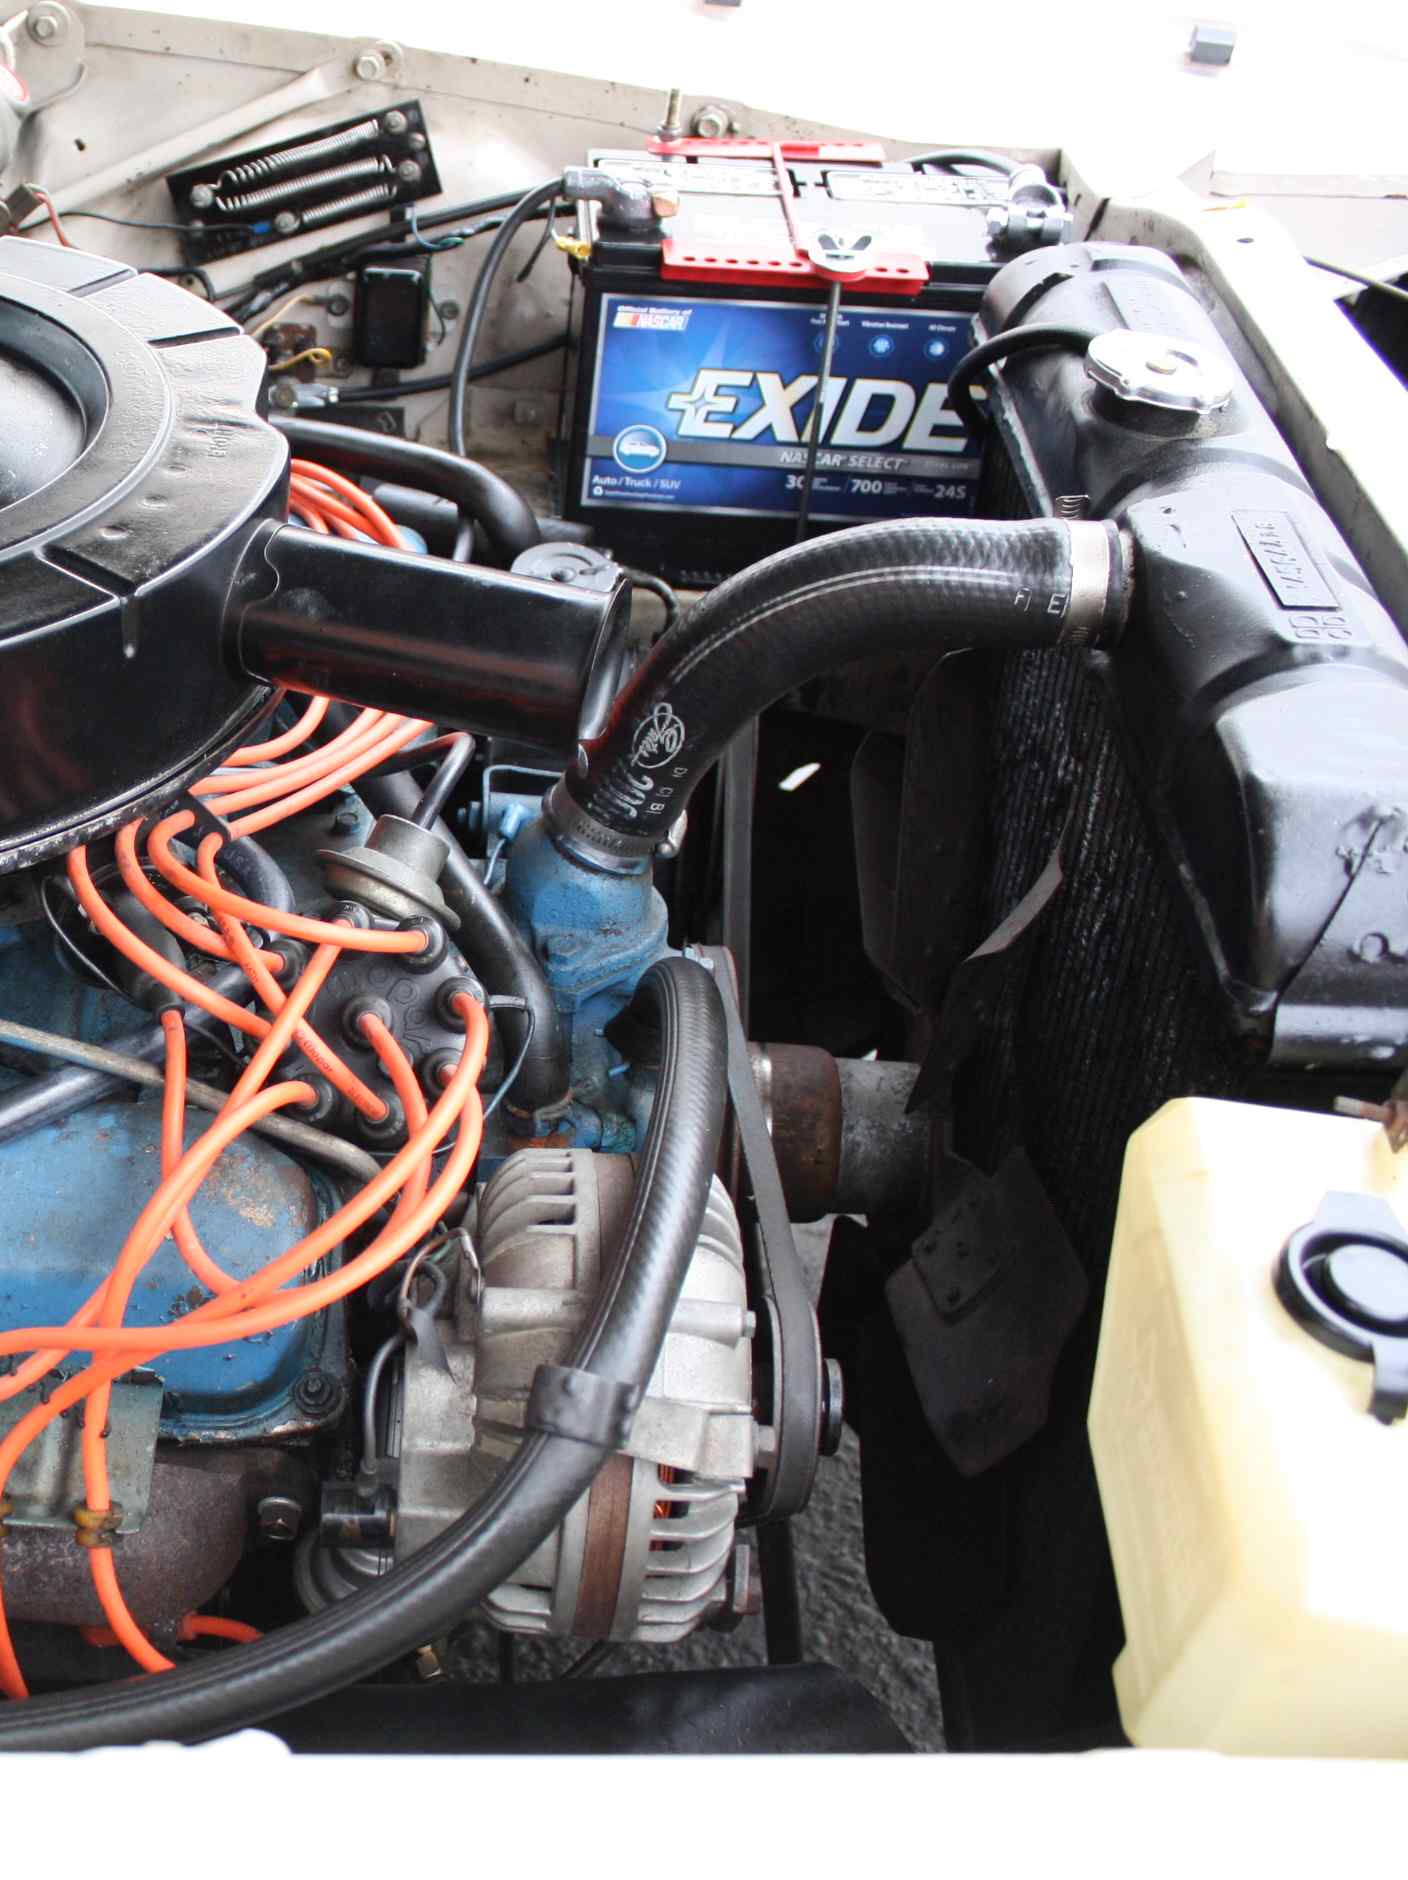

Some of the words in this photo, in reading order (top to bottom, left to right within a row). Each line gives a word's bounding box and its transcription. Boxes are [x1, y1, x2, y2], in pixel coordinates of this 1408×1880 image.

[666, 368, 985, 453] EXIDE
[780, 451, 842, 467] NAAR
[848, 455, 905, 470] SELECT
[593, 475, 617, 486] Auto
[624, 476, 652, 488] Truck
[659, 479, 682, 489] SUV
[851, 479, 882, 494] 700
[934, 484, 967, 499] 245
